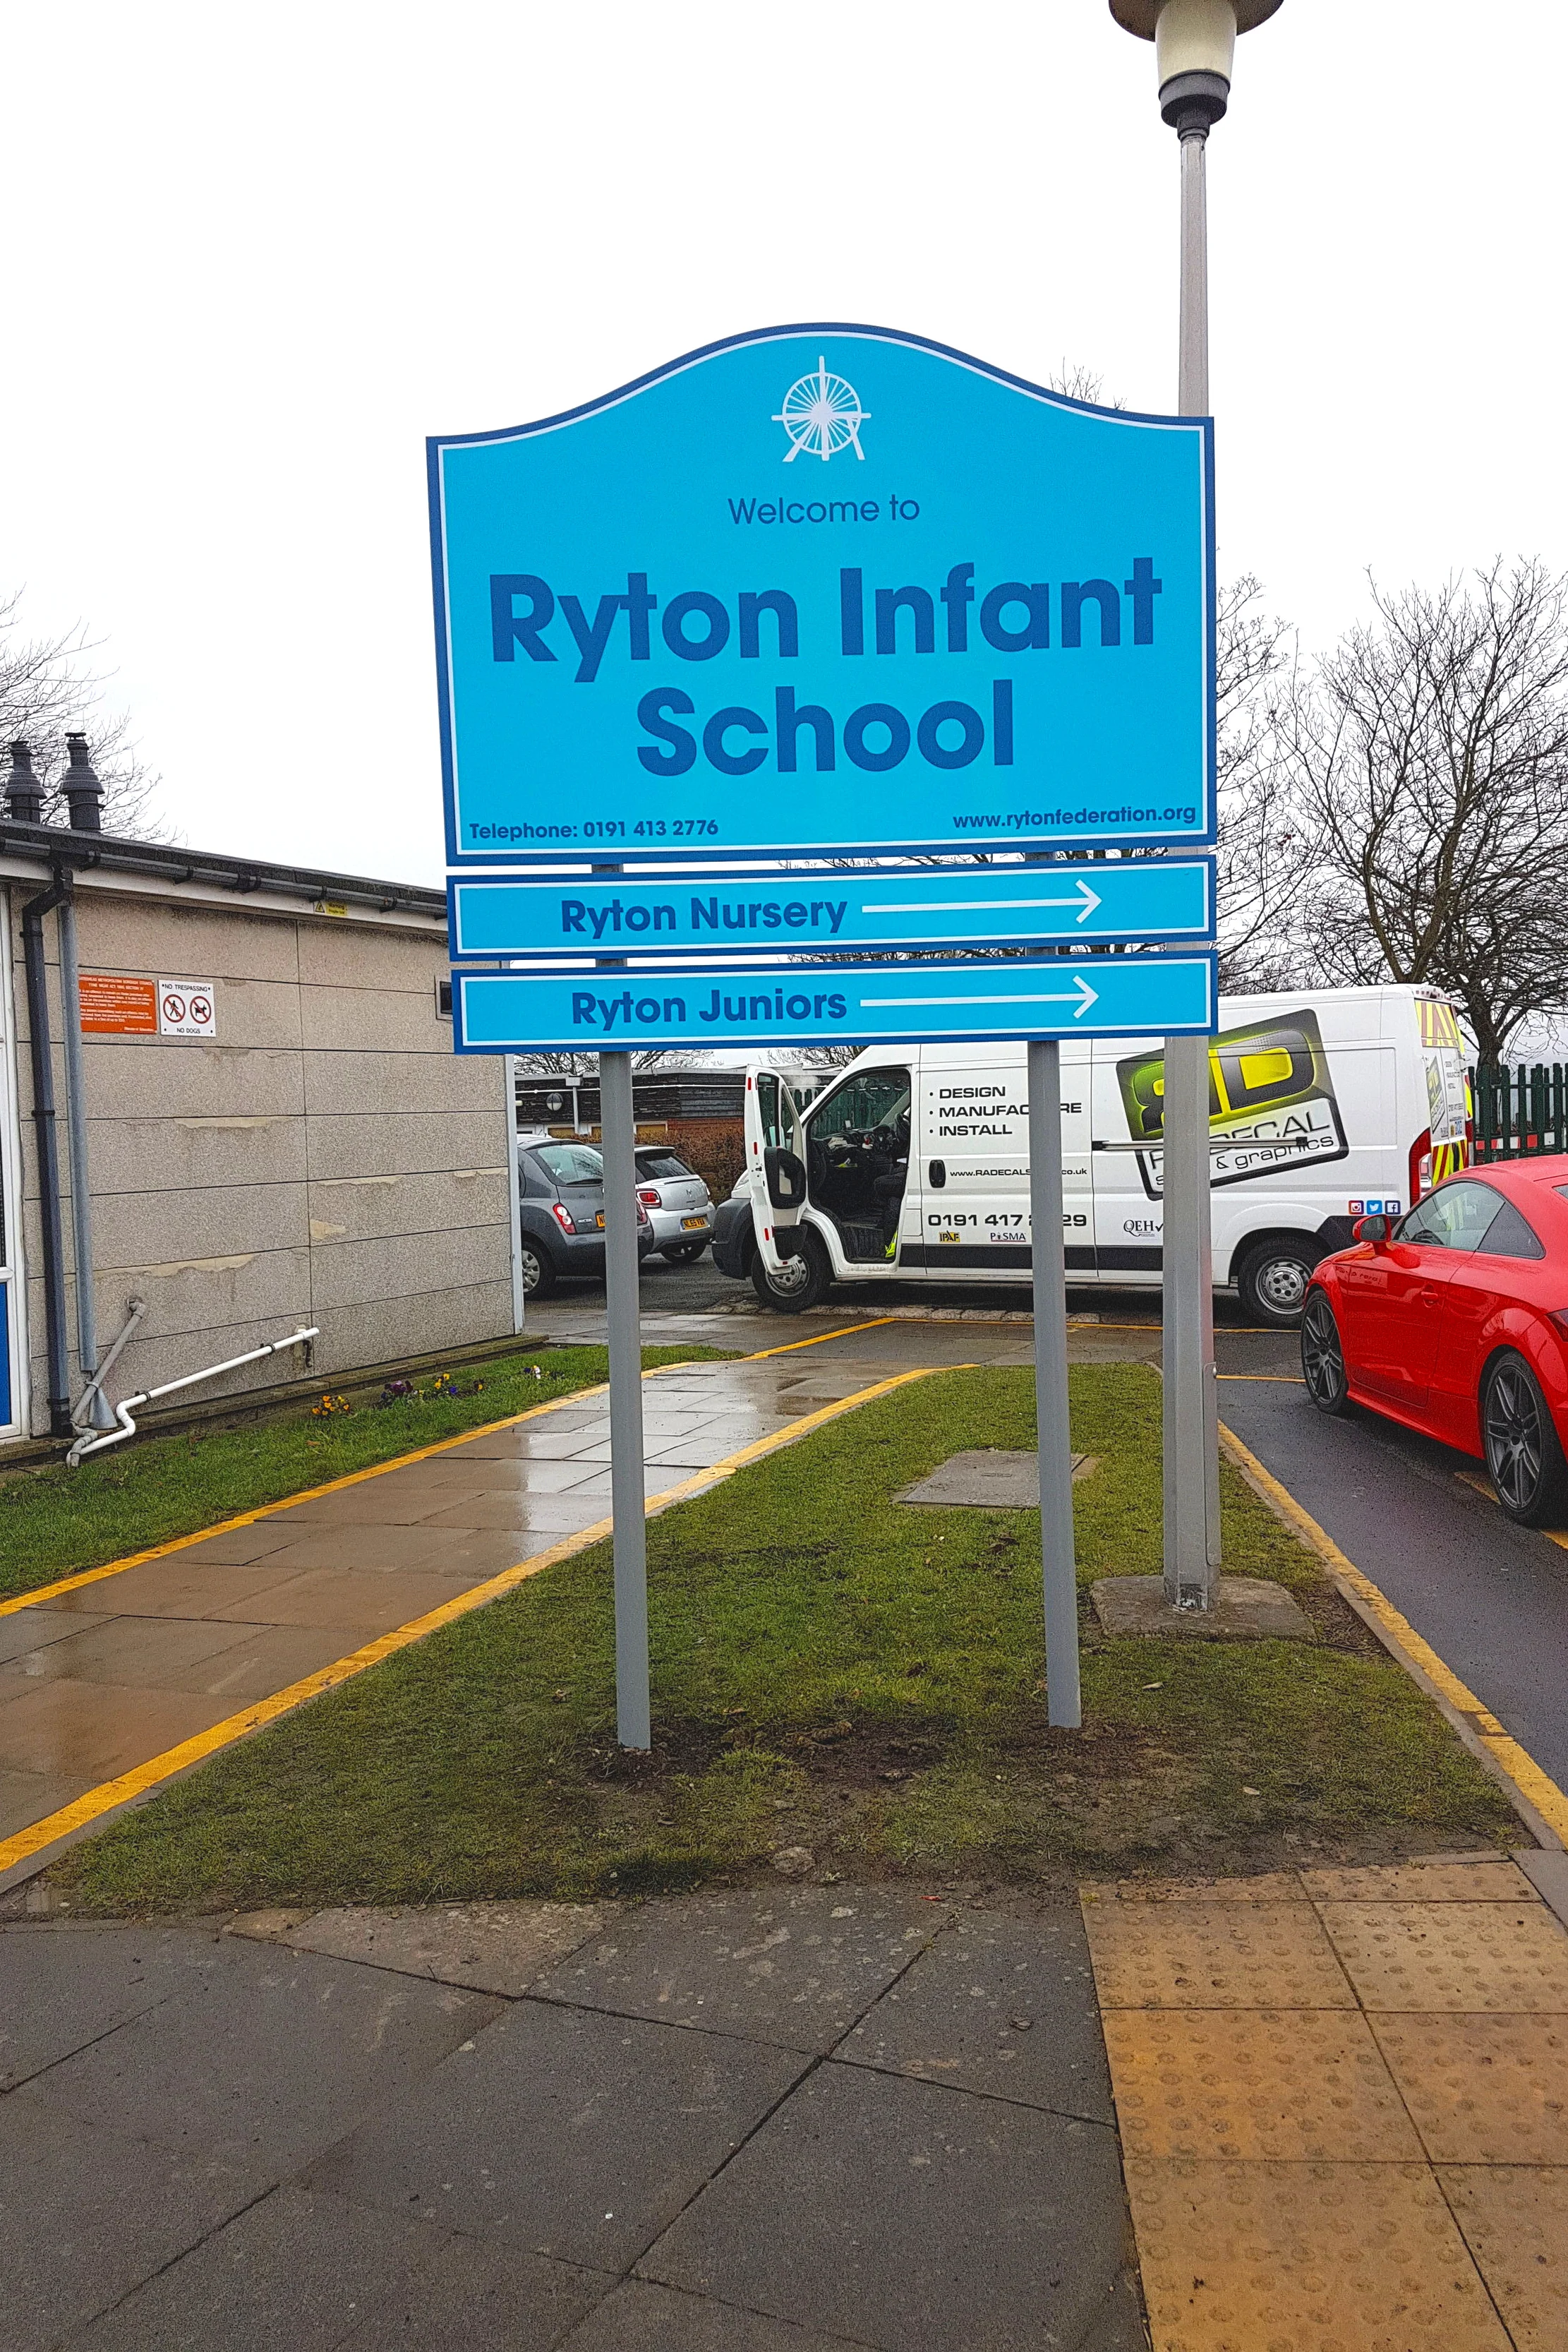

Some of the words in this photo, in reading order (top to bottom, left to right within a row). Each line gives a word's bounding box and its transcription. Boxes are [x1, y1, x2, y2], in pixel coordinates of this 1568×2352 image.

[728, 497, 879, 524] Welcome
[889, 494, 920, 521] to
[490, 572, 798, 683] Ryton
[840, 558, 1162, 655] Infant
[637, 679, 1013, 776] School
[953, 806, 1196, 828] www.rytonfederation.org
[469, 822, 578, 842] Telephone:
[584, 821, 625, 838] 0191
[634, 820, 667, 836] 413
[673, 819, 718, 836] 2776
[562, 899, 676, 939] Ryton
[692, 897, 848, 934] Nursery
[175, 984, 208, 992] TRESPASSING
[572, 992, 686, 1031] Ryton
[699, 988, 848, 1022] Juniors
[939, 1086, 1006, 1099] DESIGN
[939, 1102, 1082, 1118] MANUFACRE
[939, 1124, 1013, 1136] INSTALL
[1216, 1156, 1229, 1169] &
[950, 1168, 1087, 1177] www.RADECALSco.uk
[928, 1214, 977, 1226] 0191
[984, 1214, 1023, 1226] 417
[1029, 1214, 1087, 1227] 29
[1123, 1220, 1154, 1237] QEH
[940, 1230, 960, 1242] IPAF
